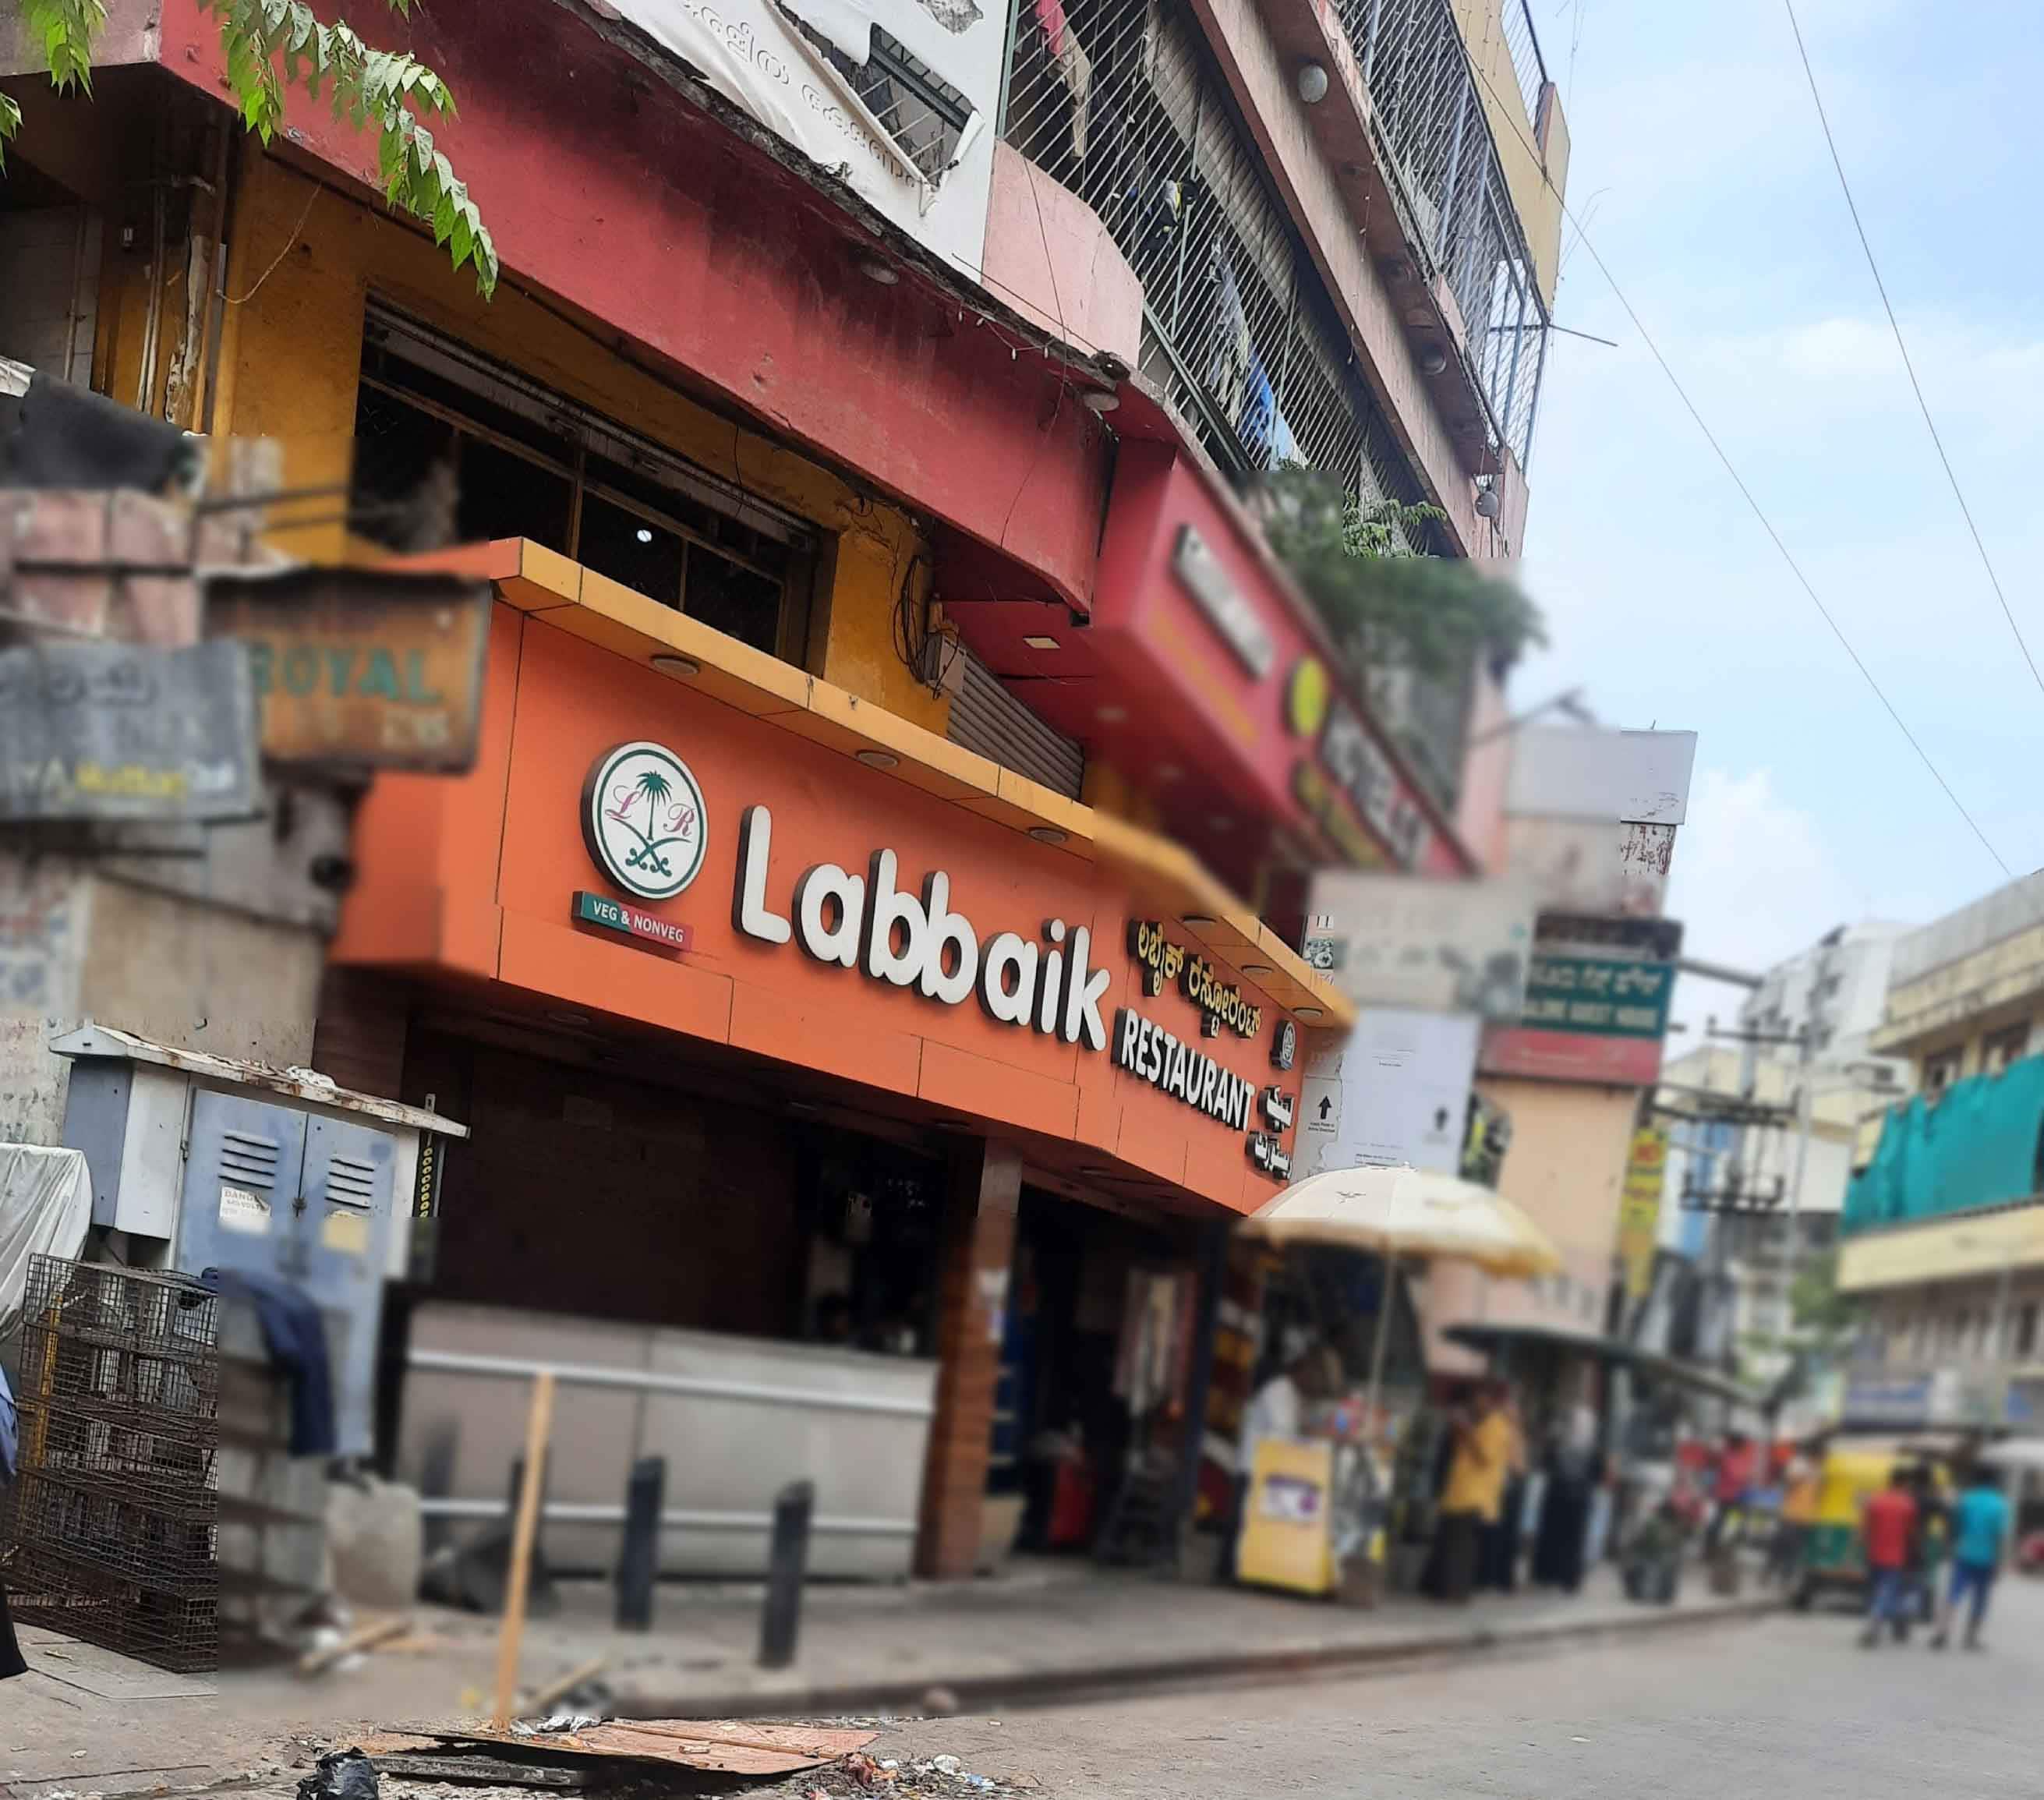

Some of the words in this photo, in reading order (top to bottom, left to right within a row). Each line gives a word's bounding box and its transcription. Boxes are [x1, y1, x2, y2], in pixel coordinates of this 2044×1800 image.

[663, 804, 695, 836] R
[592, 900, 618, 921] VEG
[621, 911, 631, 925] &
[634, 914, 684, 942] NONVEG
[740, 805, 1110, 1052] Labbaik
[1121, 1008, 1256, 1132] RESTAURANT
